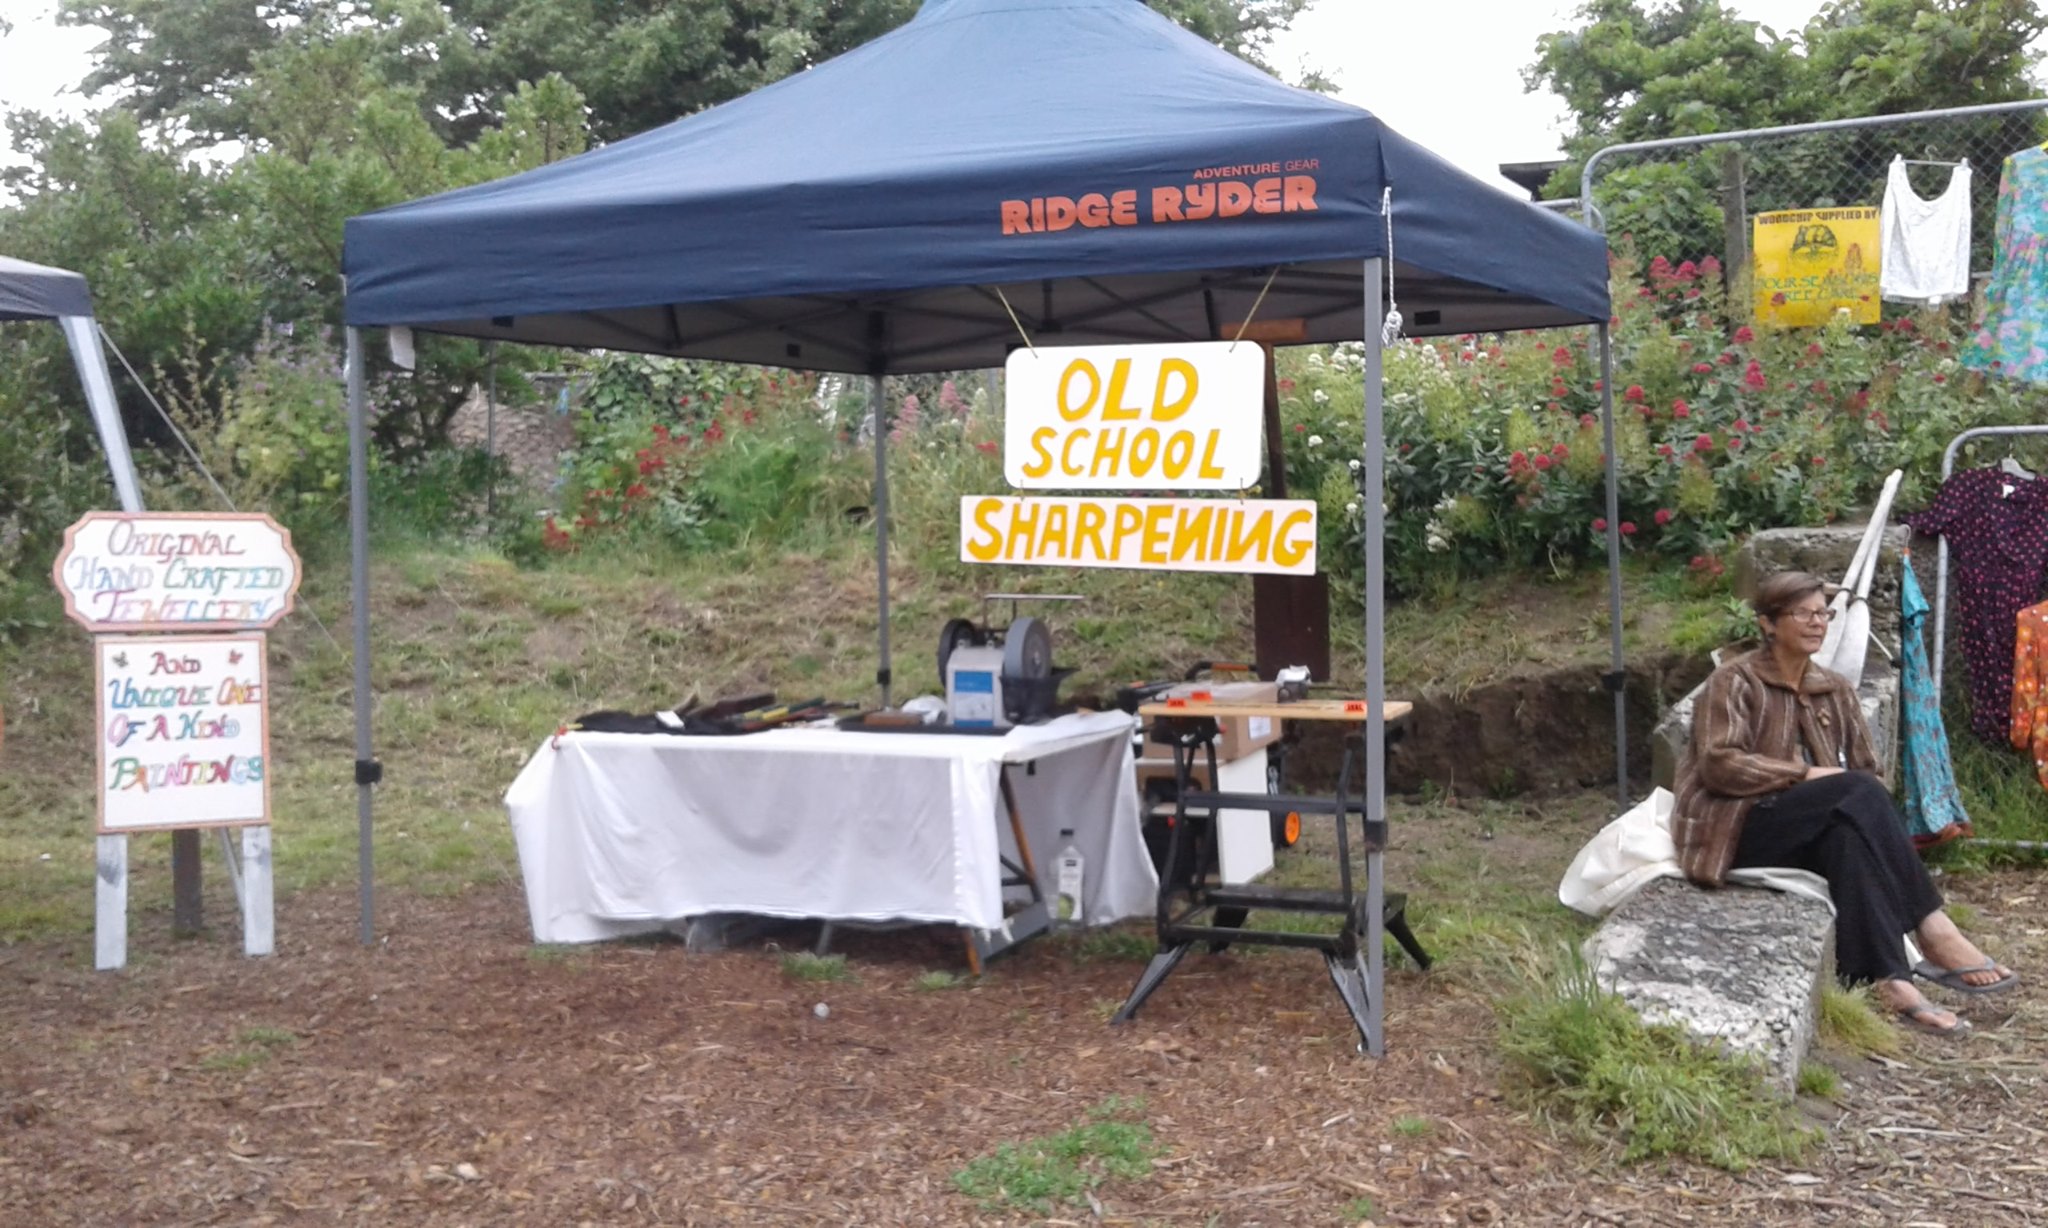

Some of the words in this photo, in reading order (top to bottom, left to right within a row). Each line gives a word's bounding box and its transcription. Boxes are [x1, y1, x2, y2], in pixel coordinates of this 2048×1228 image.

[1193, 162, 1280, 179] ADVENTURE
[1285, 159, 1319, 172] GEAR
[1001, 190, 1137, 235] RIDGE
[1152, 175, 1318, 222] RYDER
[1759, 211, 1813, 224] WOODCHIP
[1816, 209, 1862, 220] SUPPLIED
[1864, 209, 1877, 219] BY
[1757, 277, 1797, 289] OUR
[1772, 290, 1812, 302] REE
[1057, 358, 1199, 422] OLD
[1022, 426, 1225, 480] SCHOOL
[966, 498, 1314, 567] SHARPENING
[69, 556, 154, 590] HAND
[163, 557, 283, 595] CRAFTED
[150, 652, 201, 675] AND
[217, 678, 261, 705] ONE
[107, 713, 146, 747] OF
[146, 715, 170, 740] A
[109, 754, 264, 792] PAINTINGS
